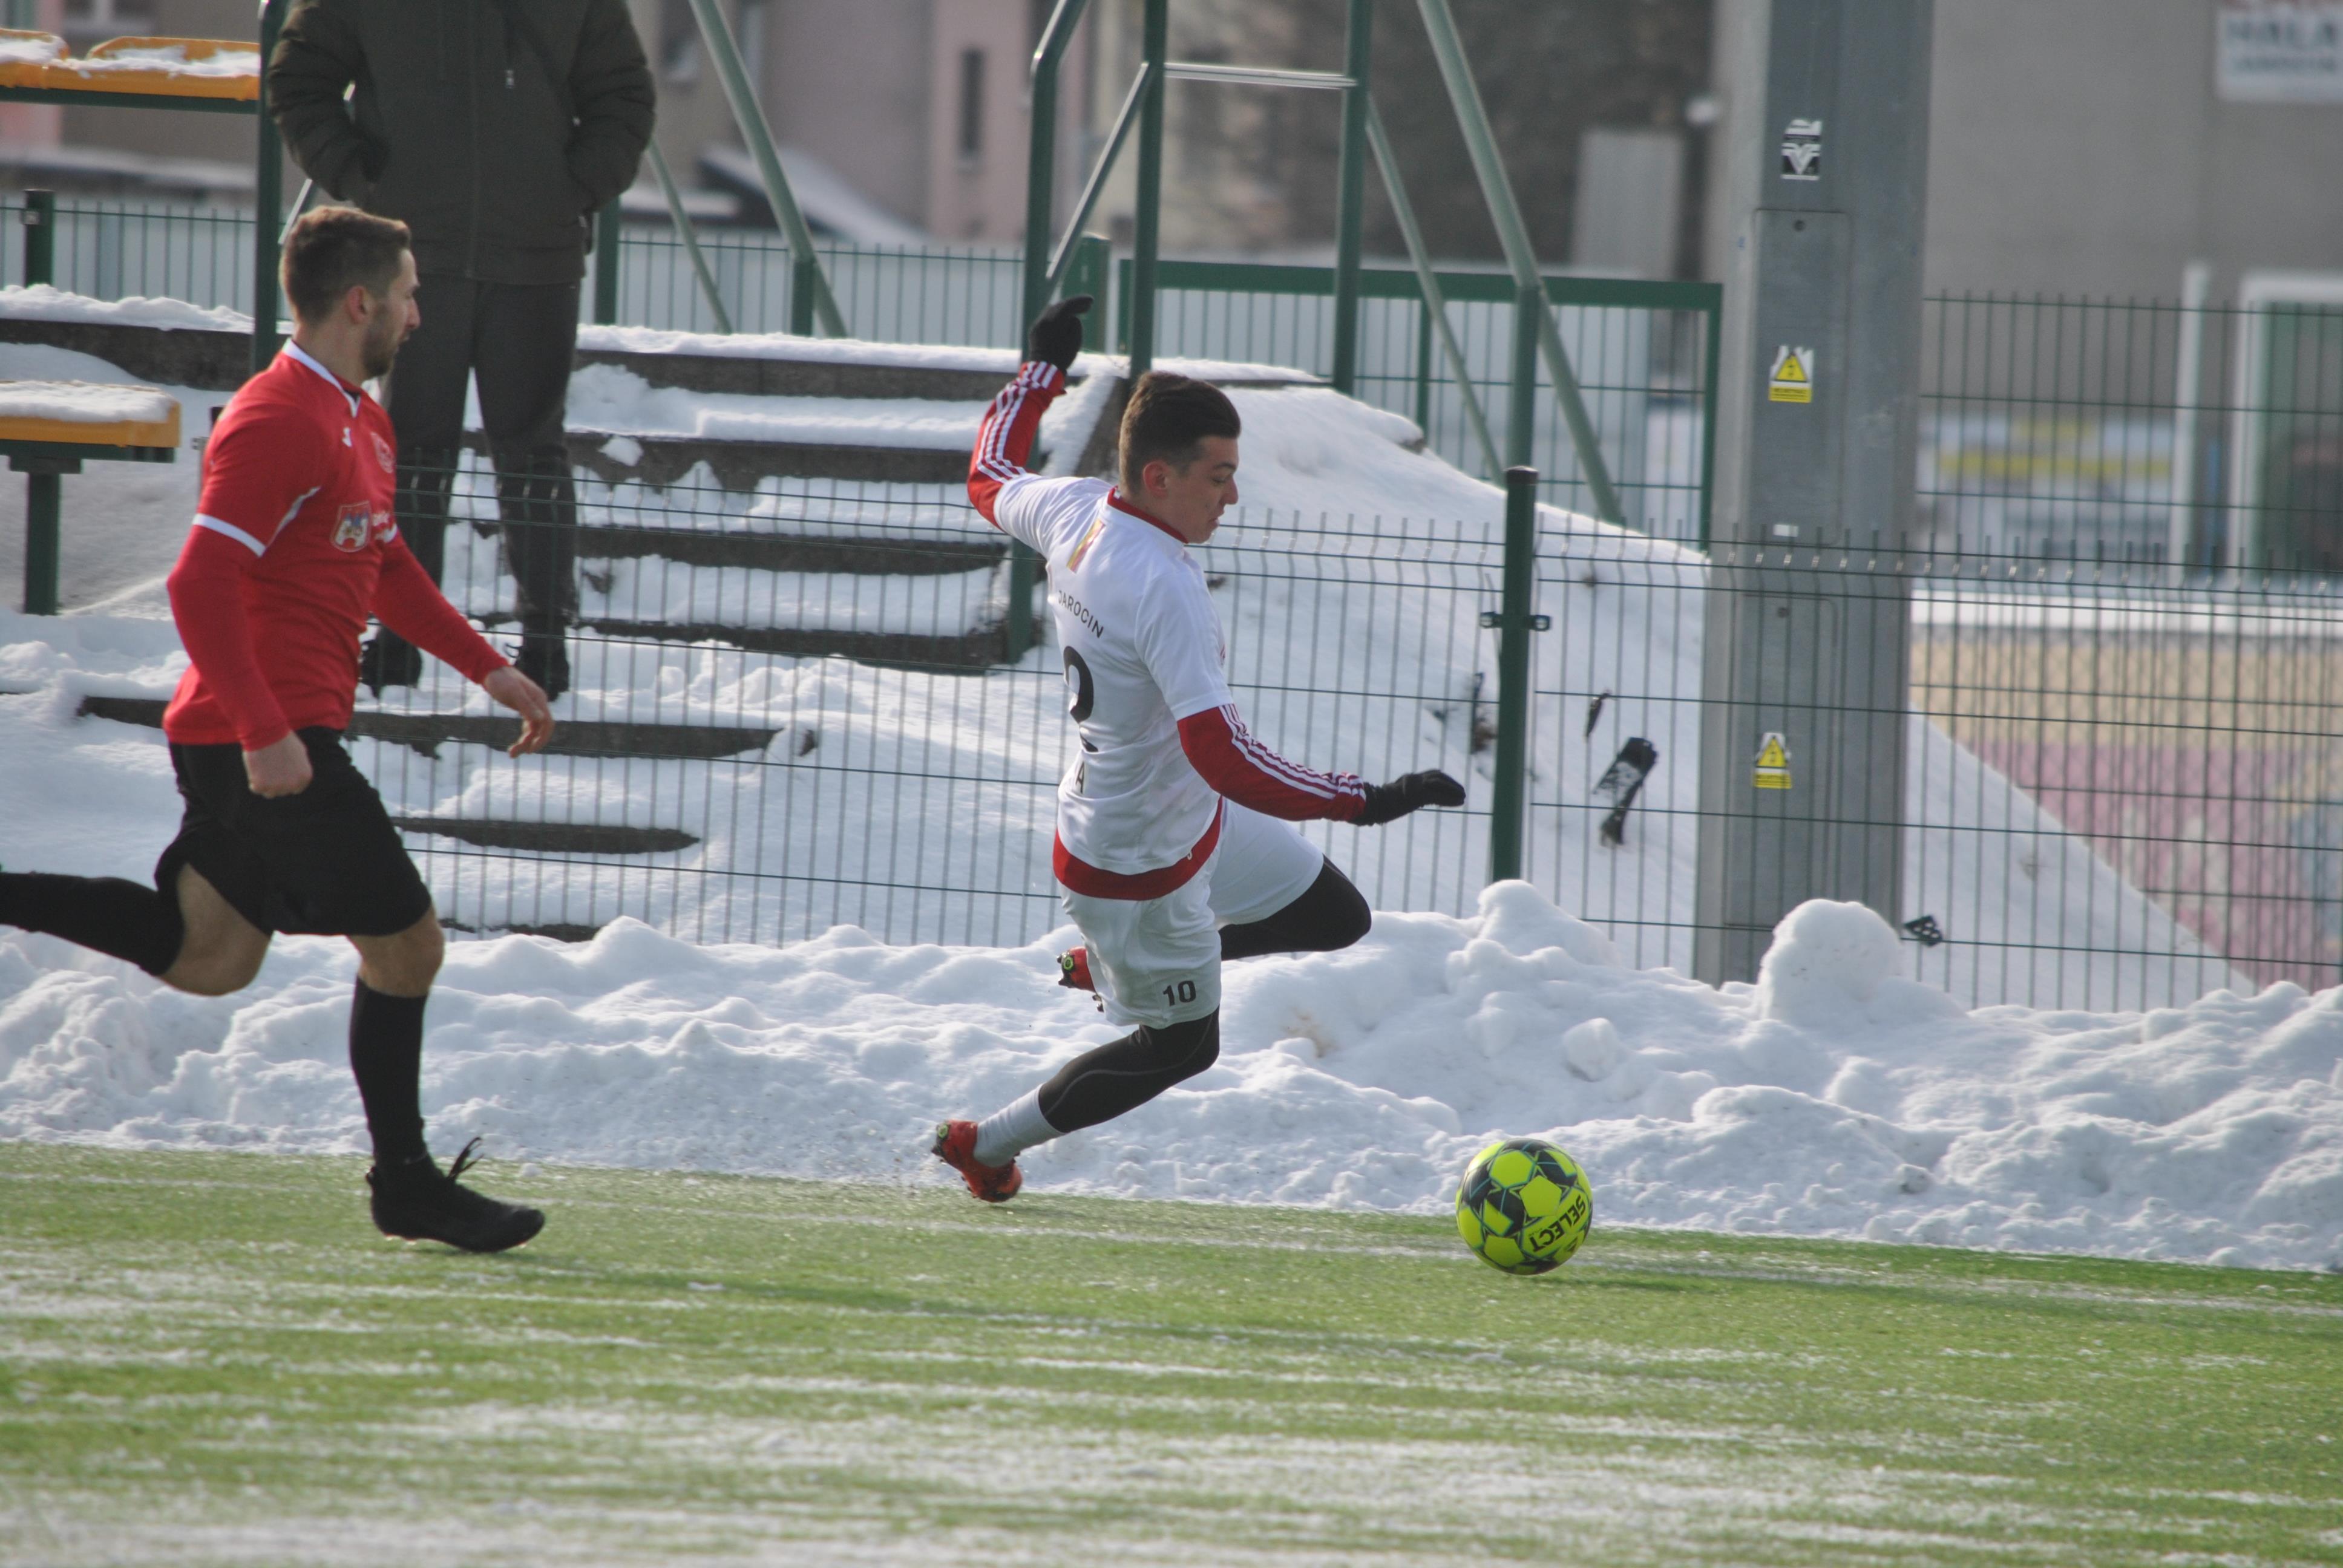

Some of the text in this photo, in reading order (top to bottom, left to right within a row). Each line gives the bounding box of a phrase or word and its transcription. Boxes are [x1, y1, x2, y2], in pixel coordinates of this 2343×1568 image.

[1058, 590, 1104, 639] JAROCIN
[1162, 980, 1196, 1007] 10
[1529, 1195, 1586, 1252] SELECT
